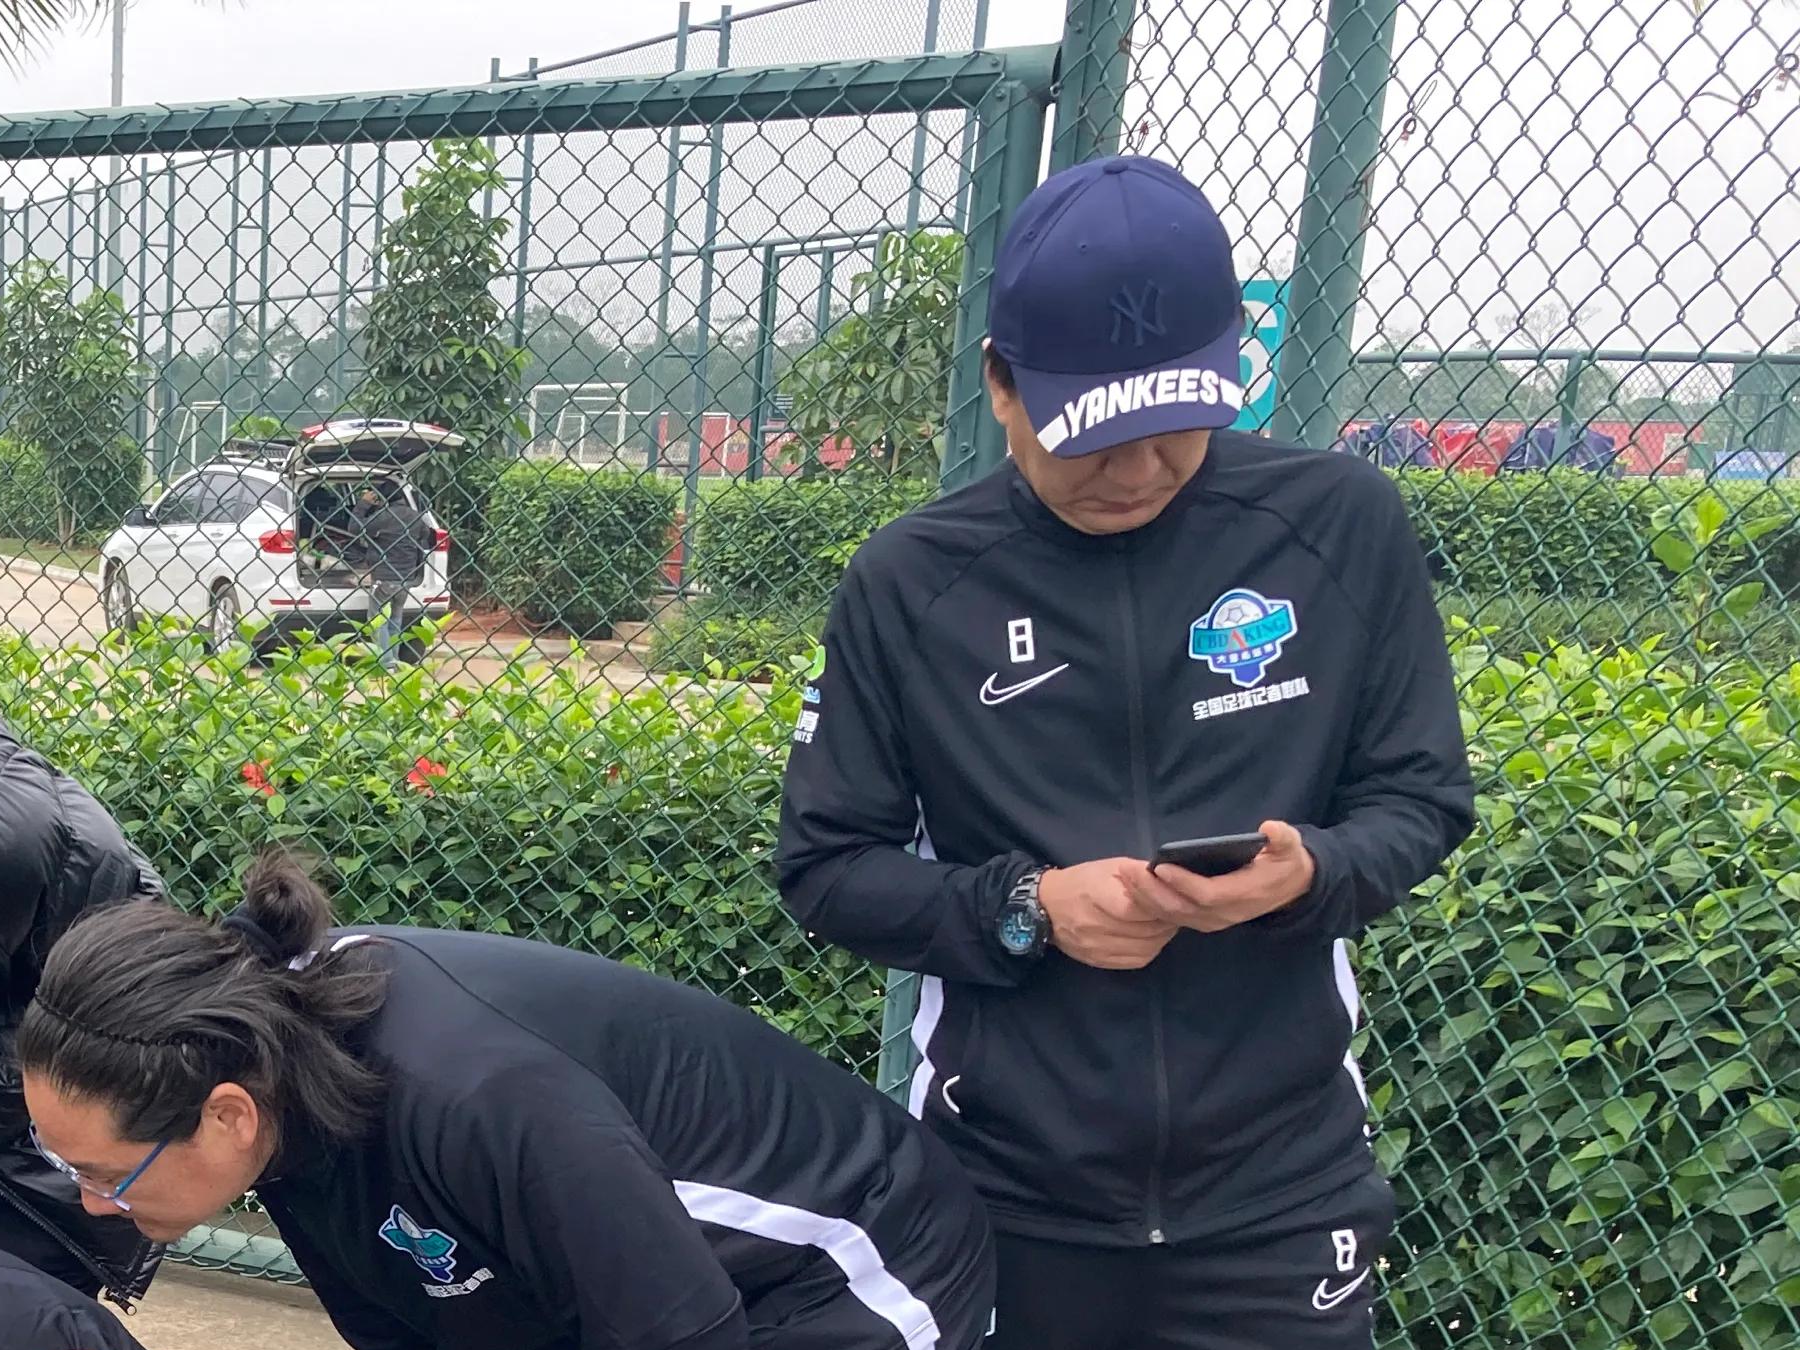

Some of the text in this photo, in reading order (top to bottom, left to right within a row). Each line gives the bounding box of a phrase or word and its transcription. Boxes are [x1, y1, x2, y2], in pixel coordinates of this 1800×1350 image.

[1064, 368, 1220, 439] YANKEES
[1007, 617, 1035, 663] 8
[1331, 1229, 1358, 1272] 8
